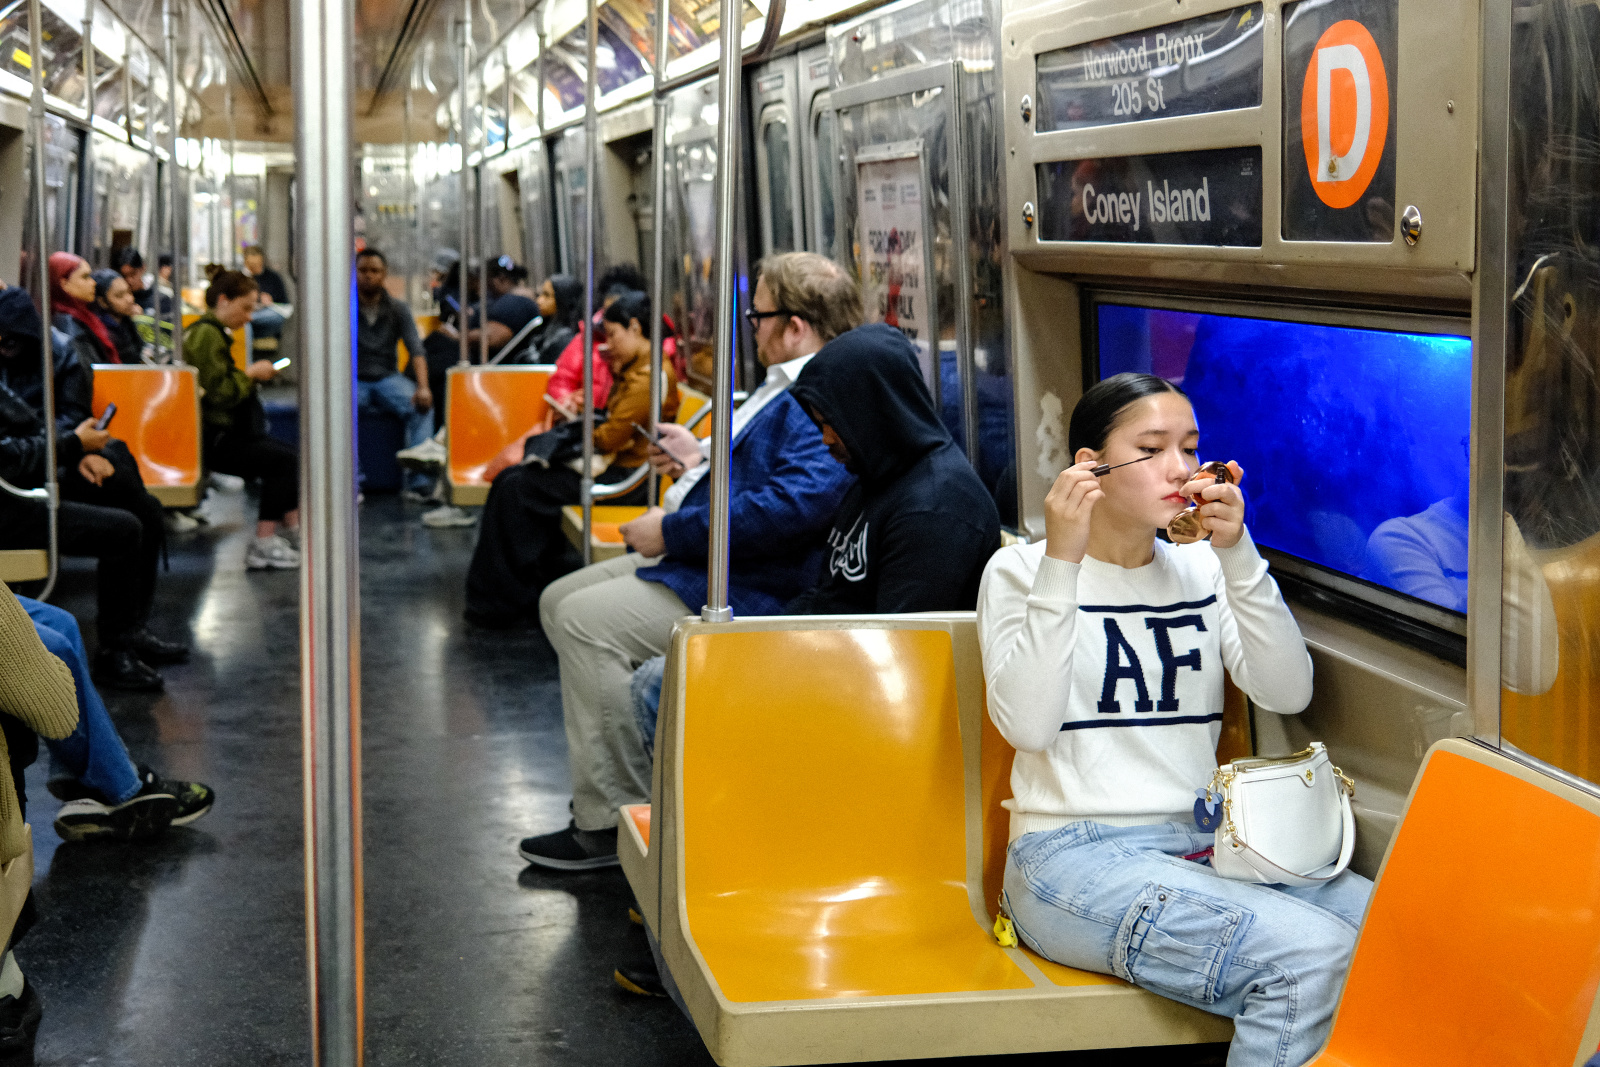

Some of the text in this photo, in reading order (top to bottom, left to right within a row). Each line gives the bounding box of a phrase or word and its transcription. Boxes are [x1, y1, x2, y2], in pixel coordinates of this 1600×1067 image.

[1082, 32, 1205, 81] Norwood, Bronx
[1111, 76, 1167, 116] 205 St
[1316, 43, 1372, 183] D
[1082, 176, 1211, 231] Coney Island
[1097, 613, 1209, 713] AF
